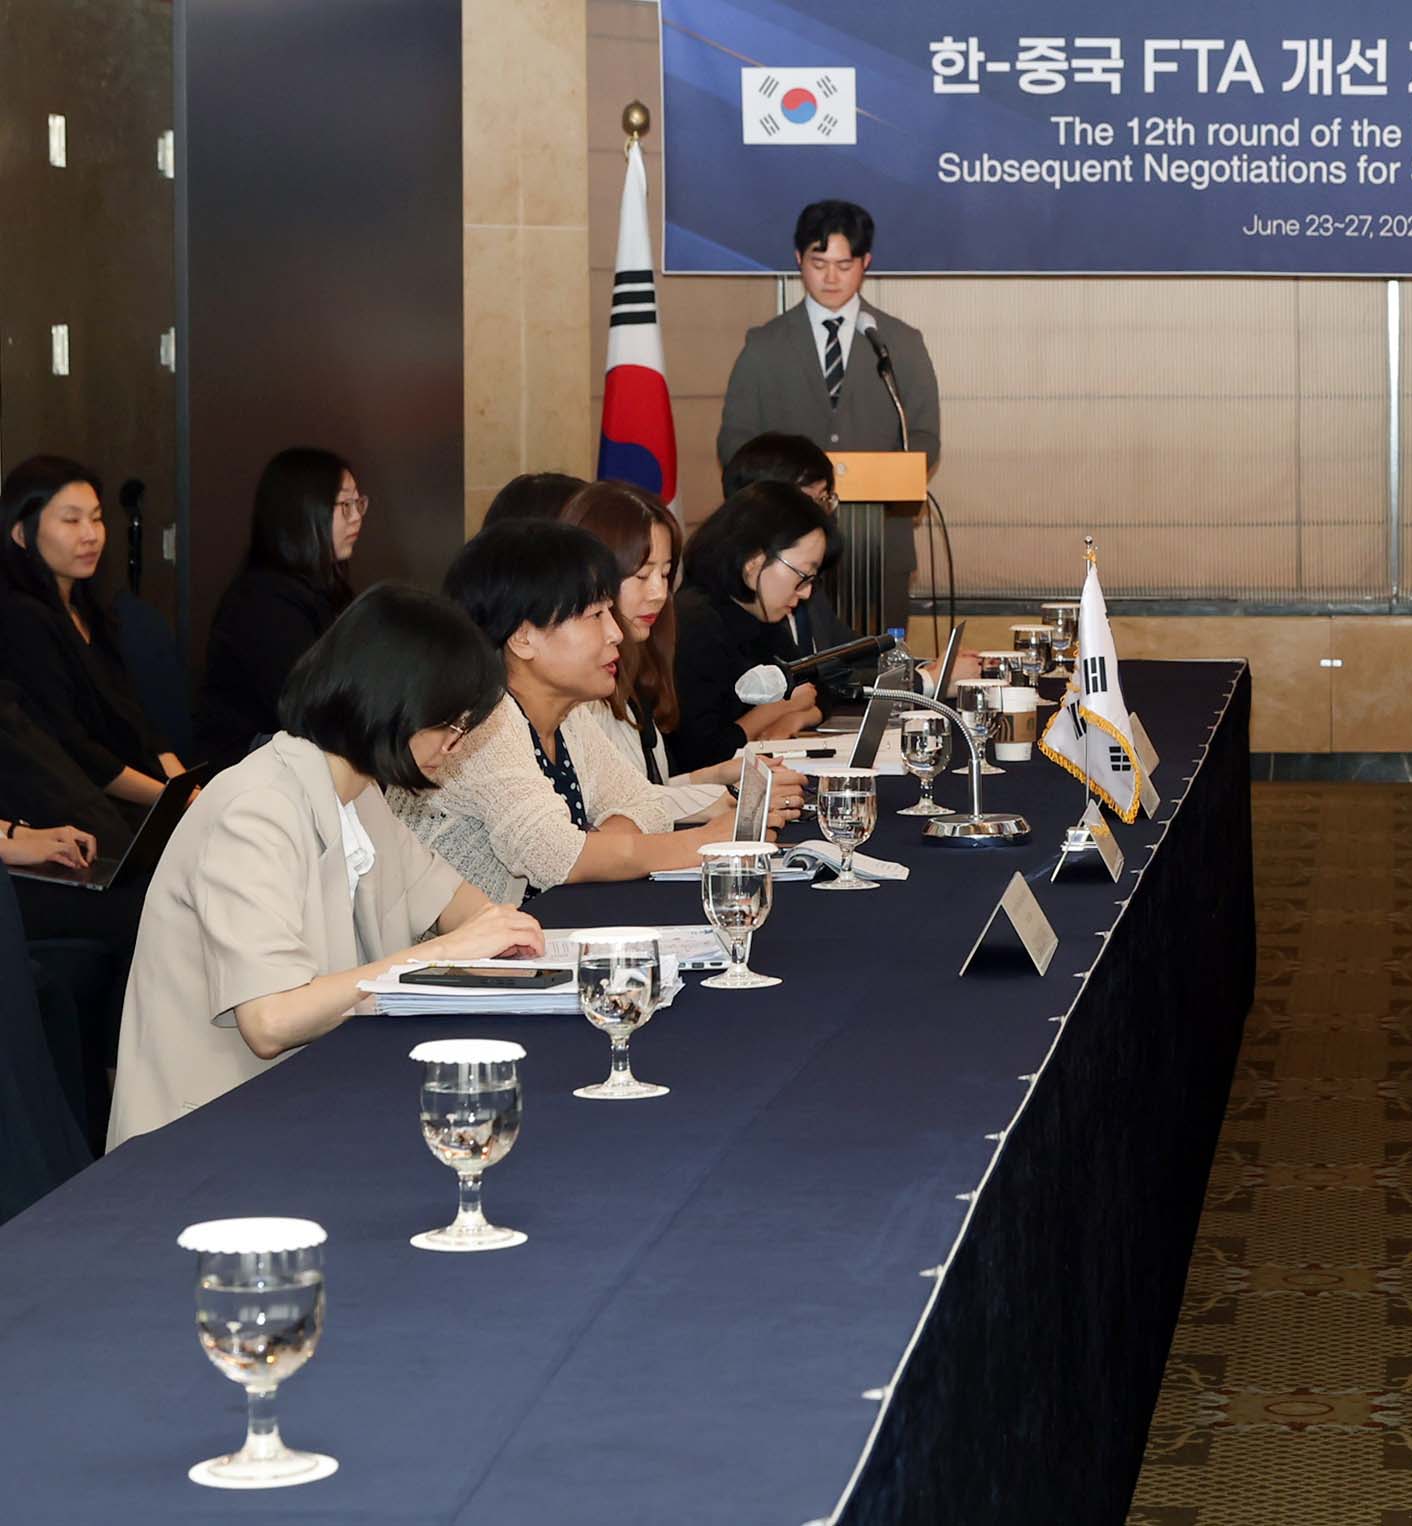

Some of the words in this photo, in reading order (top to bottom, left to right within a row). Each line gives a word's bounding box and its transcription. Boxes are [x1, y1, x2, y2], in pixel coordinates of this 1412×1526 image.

[929, 35, 1125, 95] 한-중국
[1143, 39, 1265, 94] FTA
[1281, 38, 1388, 96] 개선
[1050, 116, 1114, 146] The
[1127, 116, 1195, 146] 12th
[1207, 117, 1300, 147] round
[1310, 117, 1342, 148] of
[1350, 117, 1402, 148] the
[938, 153, 1133, 190] Subsequent
[1144, 153, 1347, 190] Negotiations
[1356, 154, 1402, 185] for
[1242, 214, 1300, 236] June
[1305, 214, 1374, 239] 23~27,
